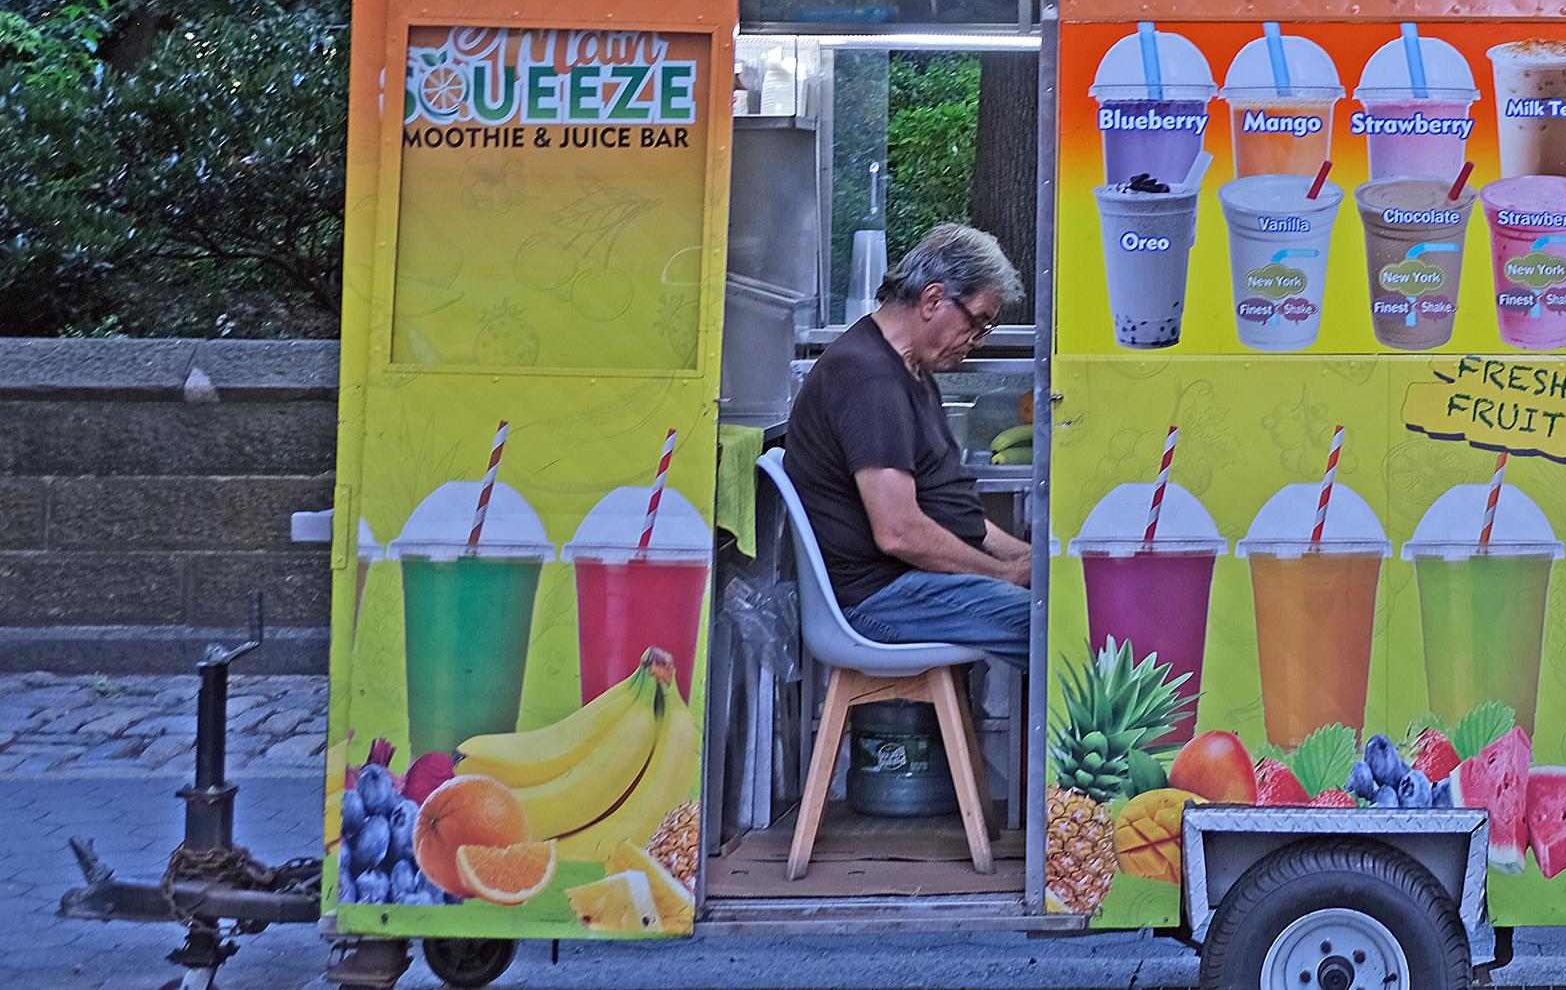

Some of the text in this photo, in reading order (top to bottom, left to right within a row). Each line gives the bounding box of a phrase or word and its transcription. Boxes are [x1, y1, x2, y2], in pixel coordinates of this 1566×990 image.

[404, 64, 694, 121] QUEEZE
[1505, 98, 1545, 118] Milk
[1098, 108, 1209, 135] Blueberry
[1242, 110, 1323, 138] Mango
[1351, 111, 1475, 140] Strawberry
[533, 126, 552, 148] &
[559, 127, 631, 148] JUICE
[640, 128, 690, 148] BAR
[1257, 216, 1312, 233] Vanilla
[1382, 208, 1463, 225] Chocolate
[1120, 231, 1171, 252] Oreo
[1382, 271, 1441, 284] New York
[1506, 263, 1566, 276] New York
[1247, 275, 1303, 288] New York
[1373, 301, 1453, 314] Finest Shake
[1498, 293, 1535, 306] Finest
[1239, 303, 1314, 316] Finest Shake
[1446, 392, 1566, 438] FRUIT
